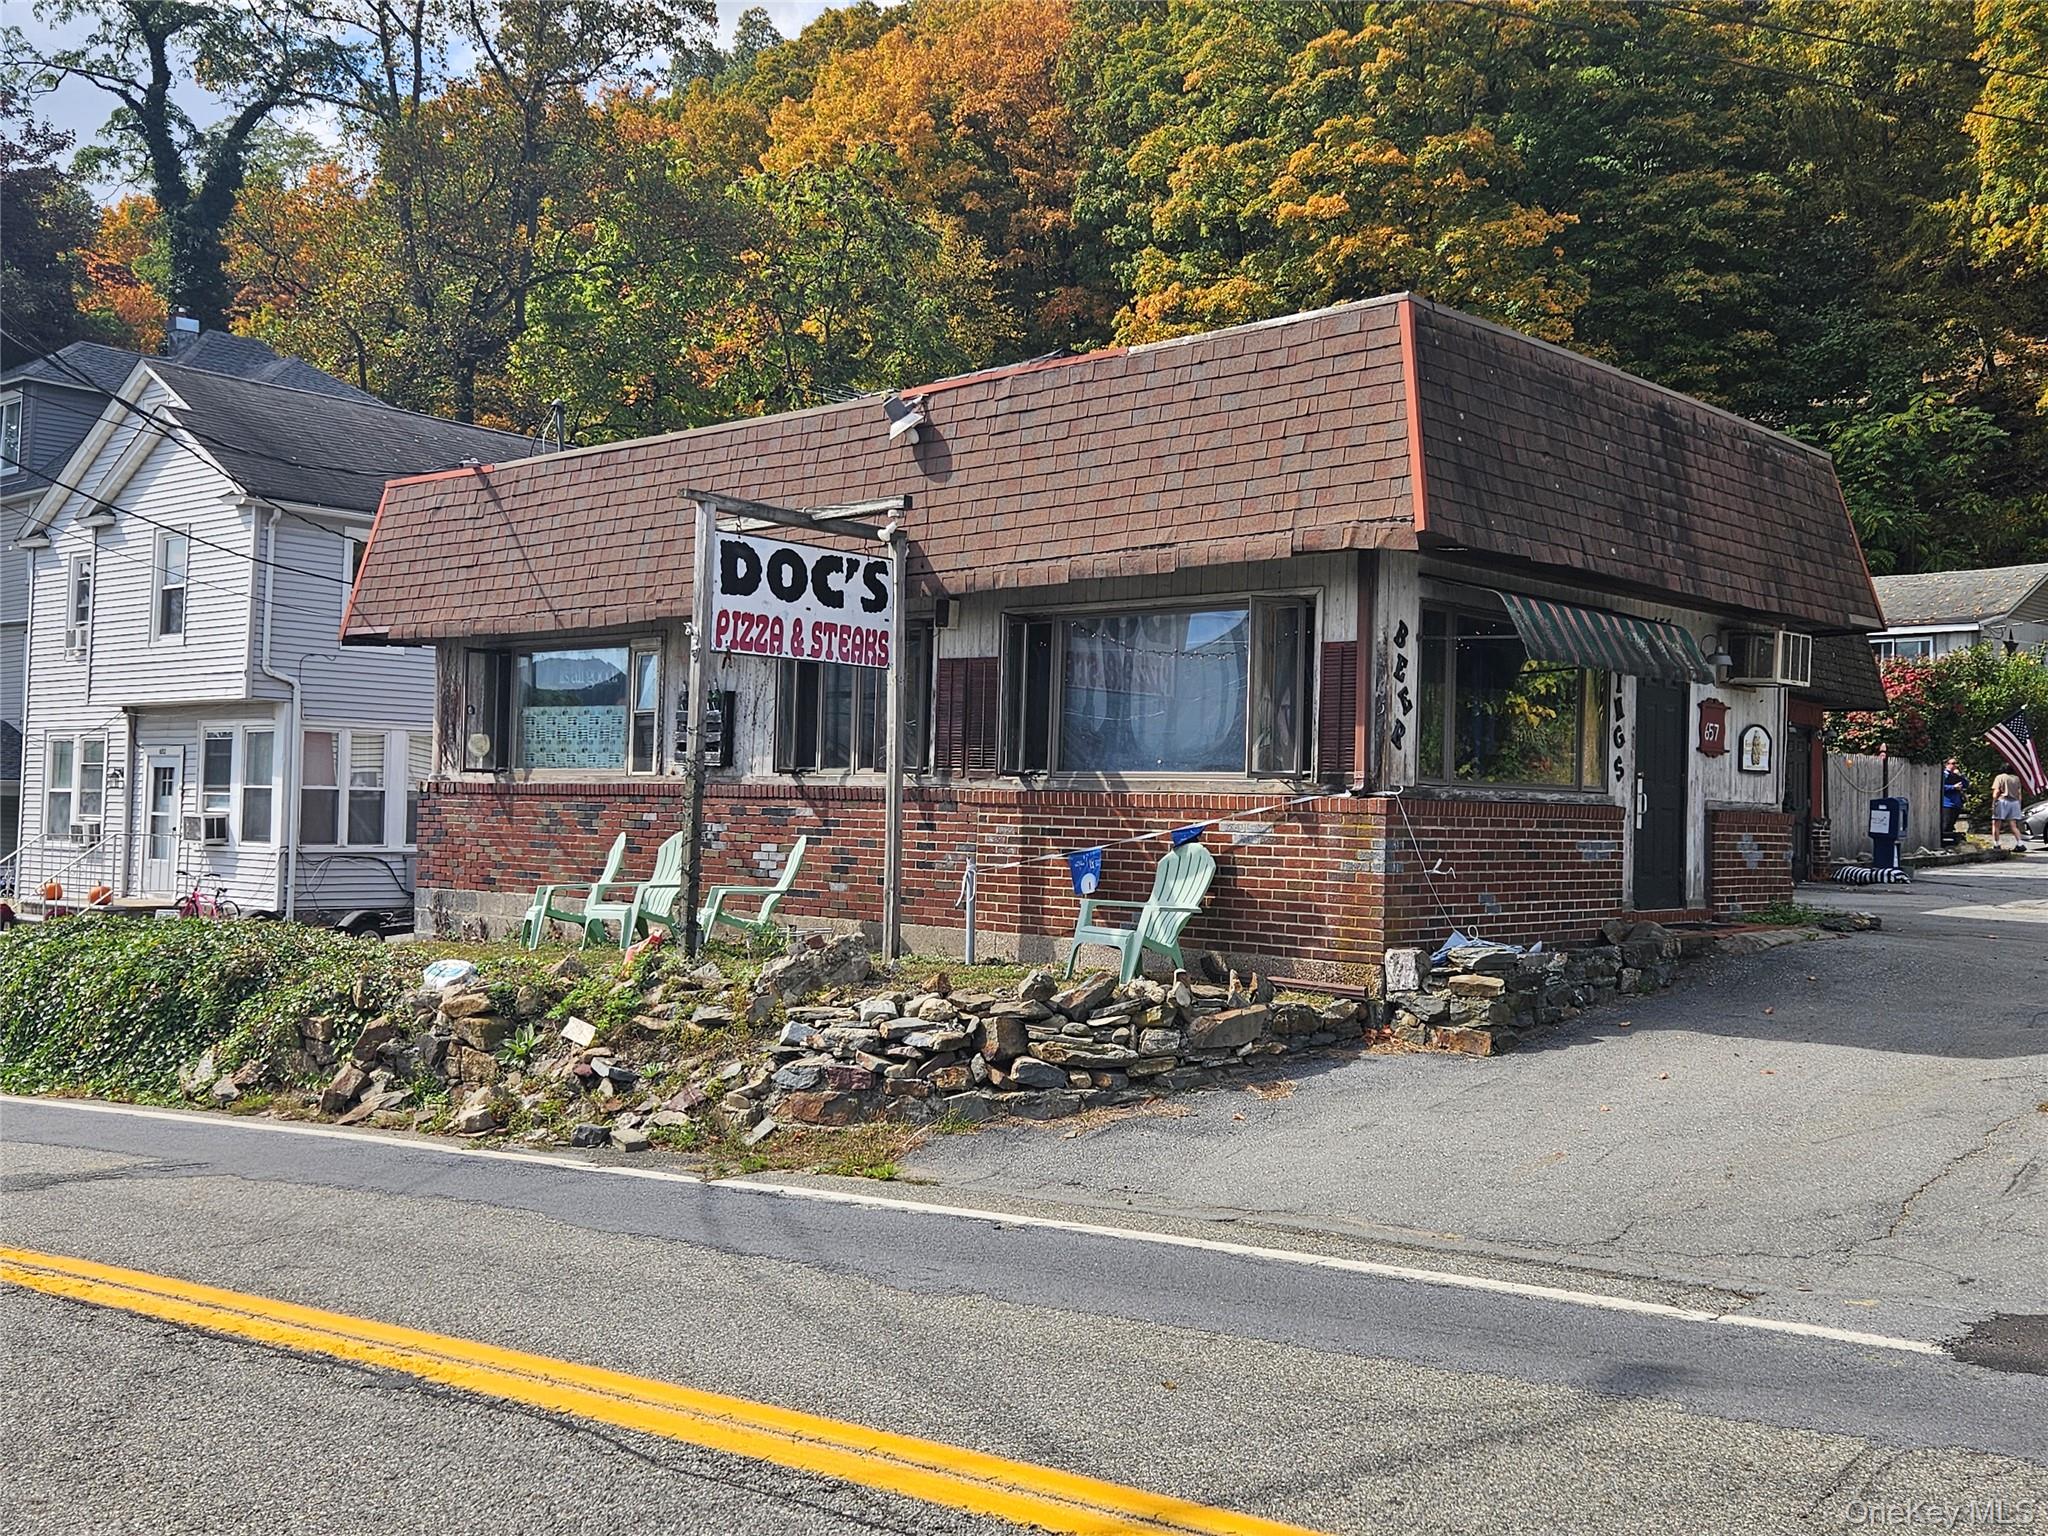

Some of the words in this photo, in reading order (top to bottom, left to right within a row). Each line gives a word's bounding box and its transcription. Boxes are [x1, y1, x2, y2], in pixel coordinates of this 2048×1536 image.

[720, 539, 889, 613] DOC'S
[716, 609, 784, 655] PIZZA
[790, 618, 804, 657] &
[811, 621, 889, 667] STEAKS
[1704, 722, 1719, 741] 657
